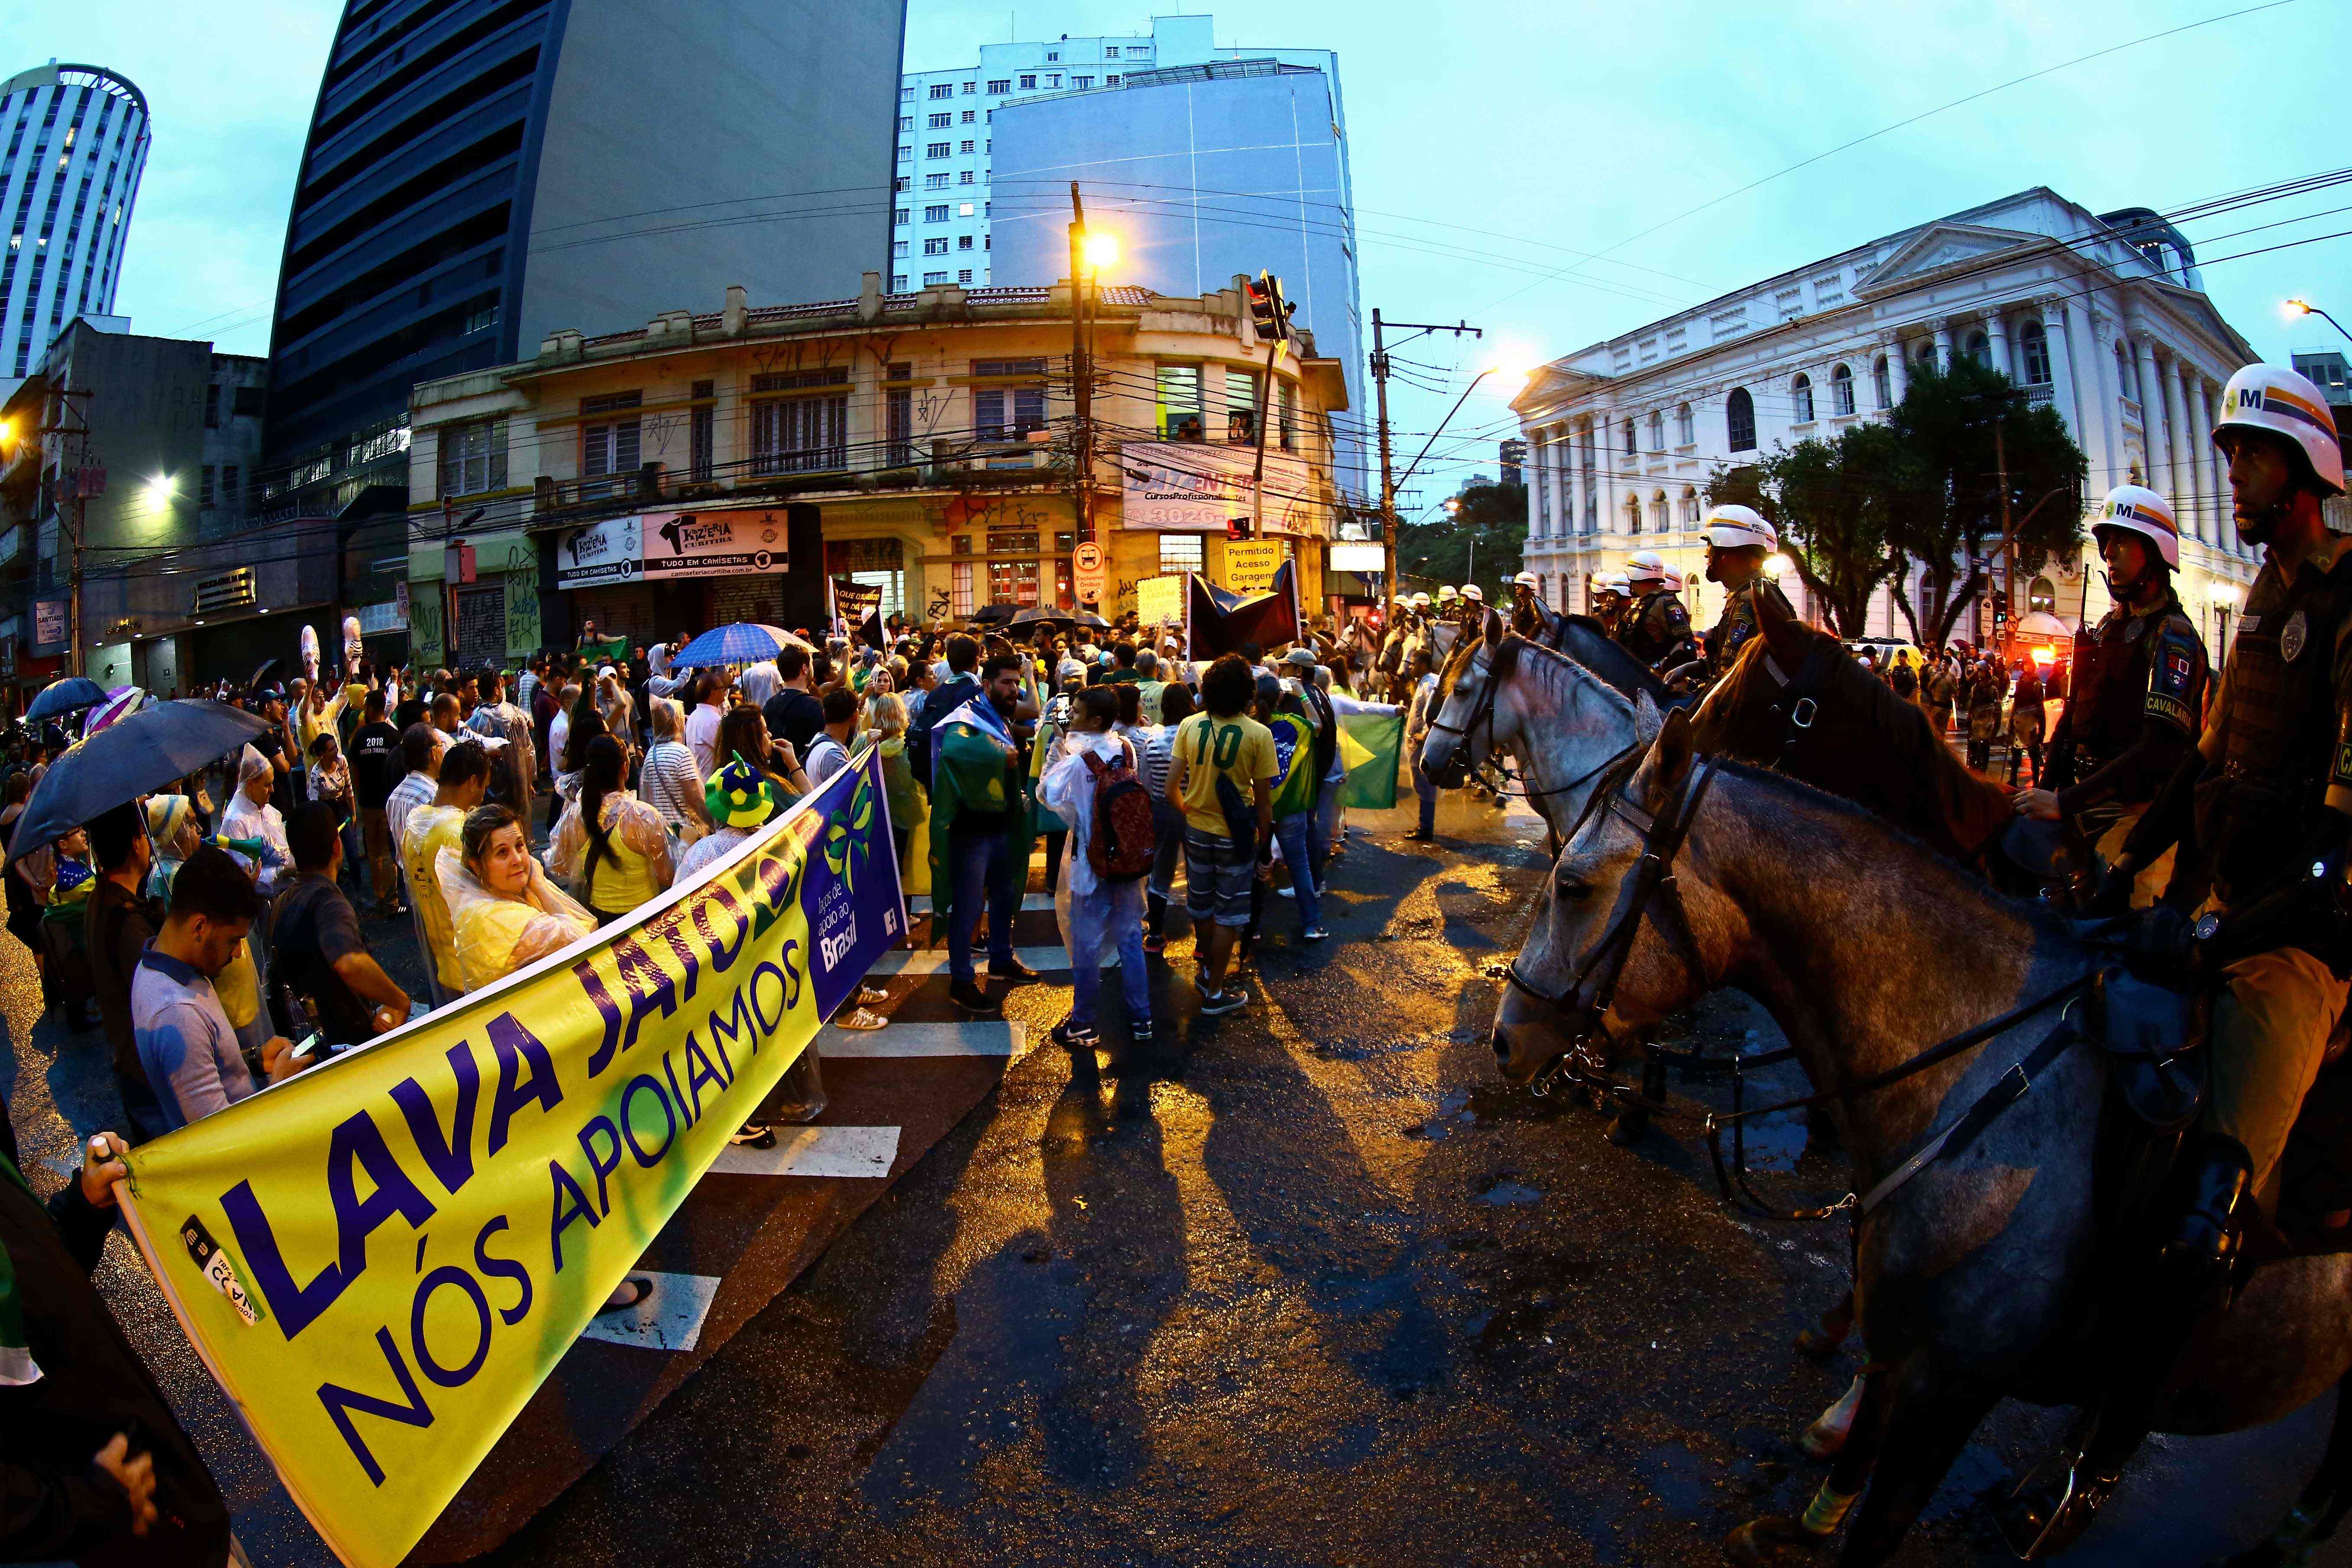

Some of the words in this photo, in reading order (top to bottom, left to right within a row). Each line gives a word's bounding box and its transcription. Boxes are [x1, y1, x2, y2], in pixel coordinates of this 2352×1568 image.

[2240, 389, 2261, 409] M
[2116, 503, 2132, 518] M
[685, 537, 732, 548] CURITIBA
[579, 547, 607, 560] CURITIBA
[1229, 547, 1274, 557] Permitido
[1236, 559, 1270, 569] Acesso
[671, 568, 753, 577] camiseteriacuritiba.com.br
[1231, 572, 1275, 582] Garagens
[37, 615, 63, 623] SANTIAGO
[366, 737, 383, 747] 2018
[1196, 720, 1243, 770] 10
[818, 891, 832, 915] laços
[832, 880, 842, 900] de
[818, 909, 838, 938] apoio
[839, 903, 849, 919] ao
[820, 910, 857, 973] Brasil
[219, 1011, 564, 1342] LAVA
[571, 881, 749, 1079] JATO
[315, 1215, 533, 1488] NÓS
[551, 938, 801, 1273] APOIAMOS
